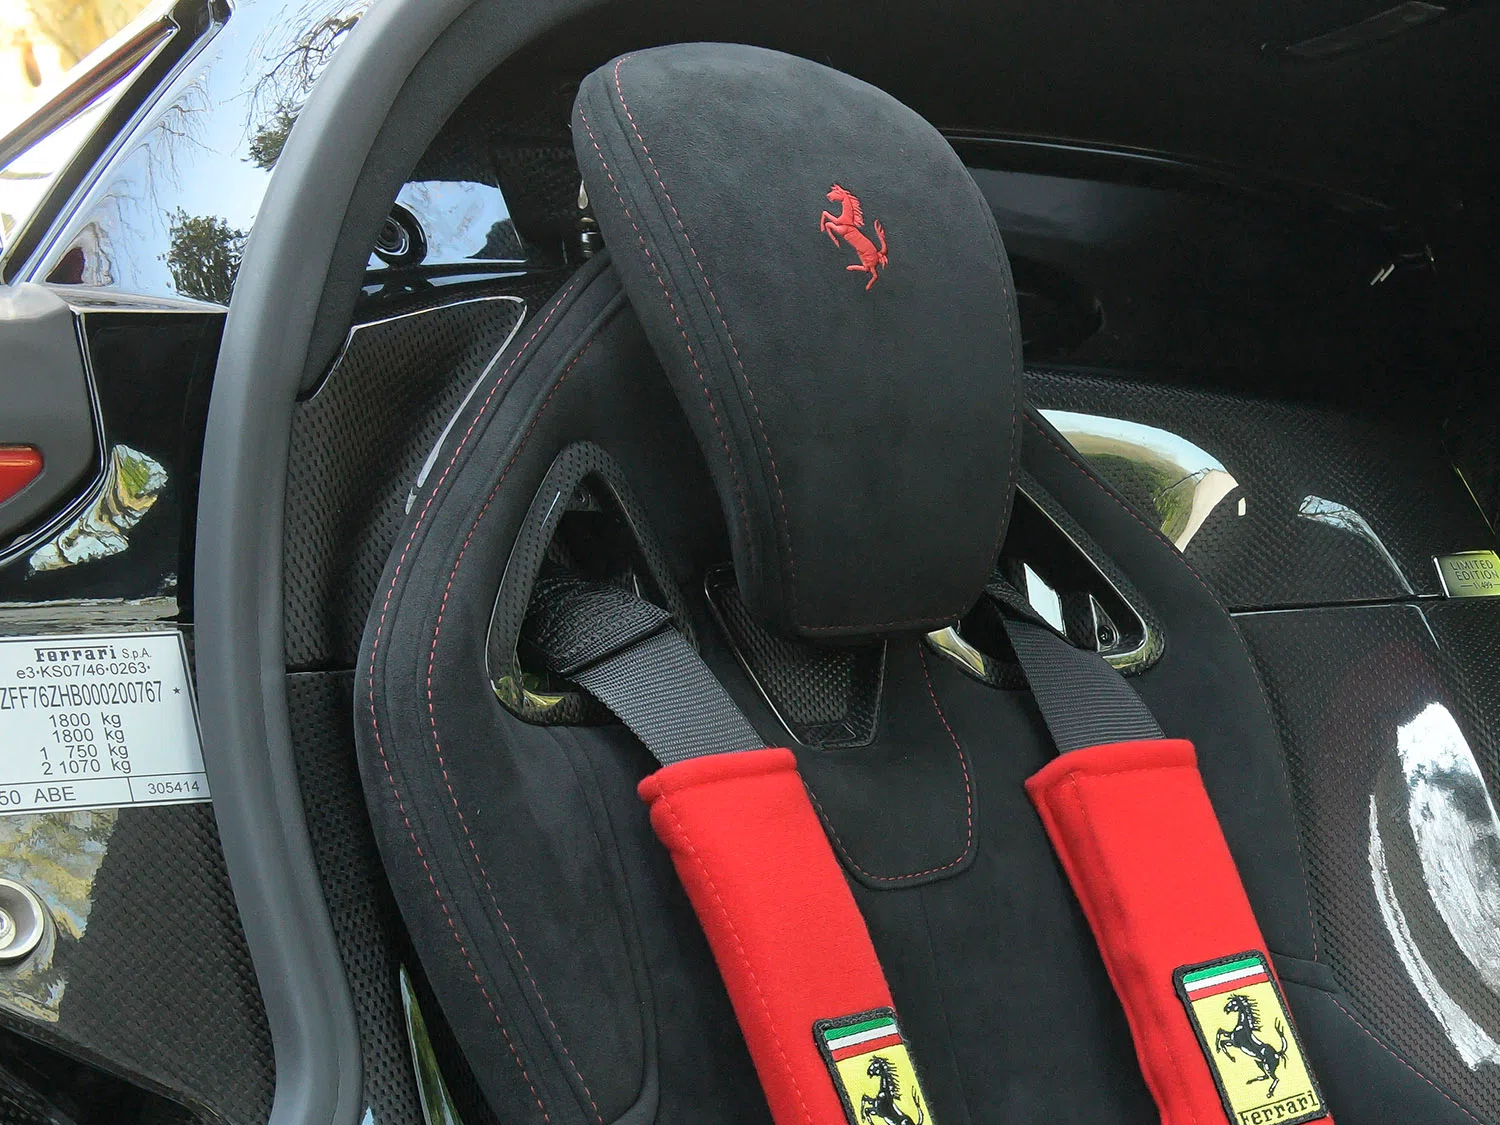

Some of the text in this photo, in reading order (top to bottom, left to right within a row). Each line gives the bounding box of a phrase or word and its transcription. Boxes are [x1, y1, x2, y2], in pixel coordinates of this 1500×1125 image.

[1450, 559, 1494, 571] LIMITED
[1455, 570, 1500, 581] EDITION
[34, 645, 152, 662] Ferrari S.p.A.
[48, 712, 122, 728] 1800 kg
[52, 727, 125, 744] 1800 kg
[40, 743, 129, 760] 1 750 kg
[41, 758, 132, 775] 2 1070 kg
[34, 786, 77, 803] ABE
[147, 781, 200, 795] 305414
